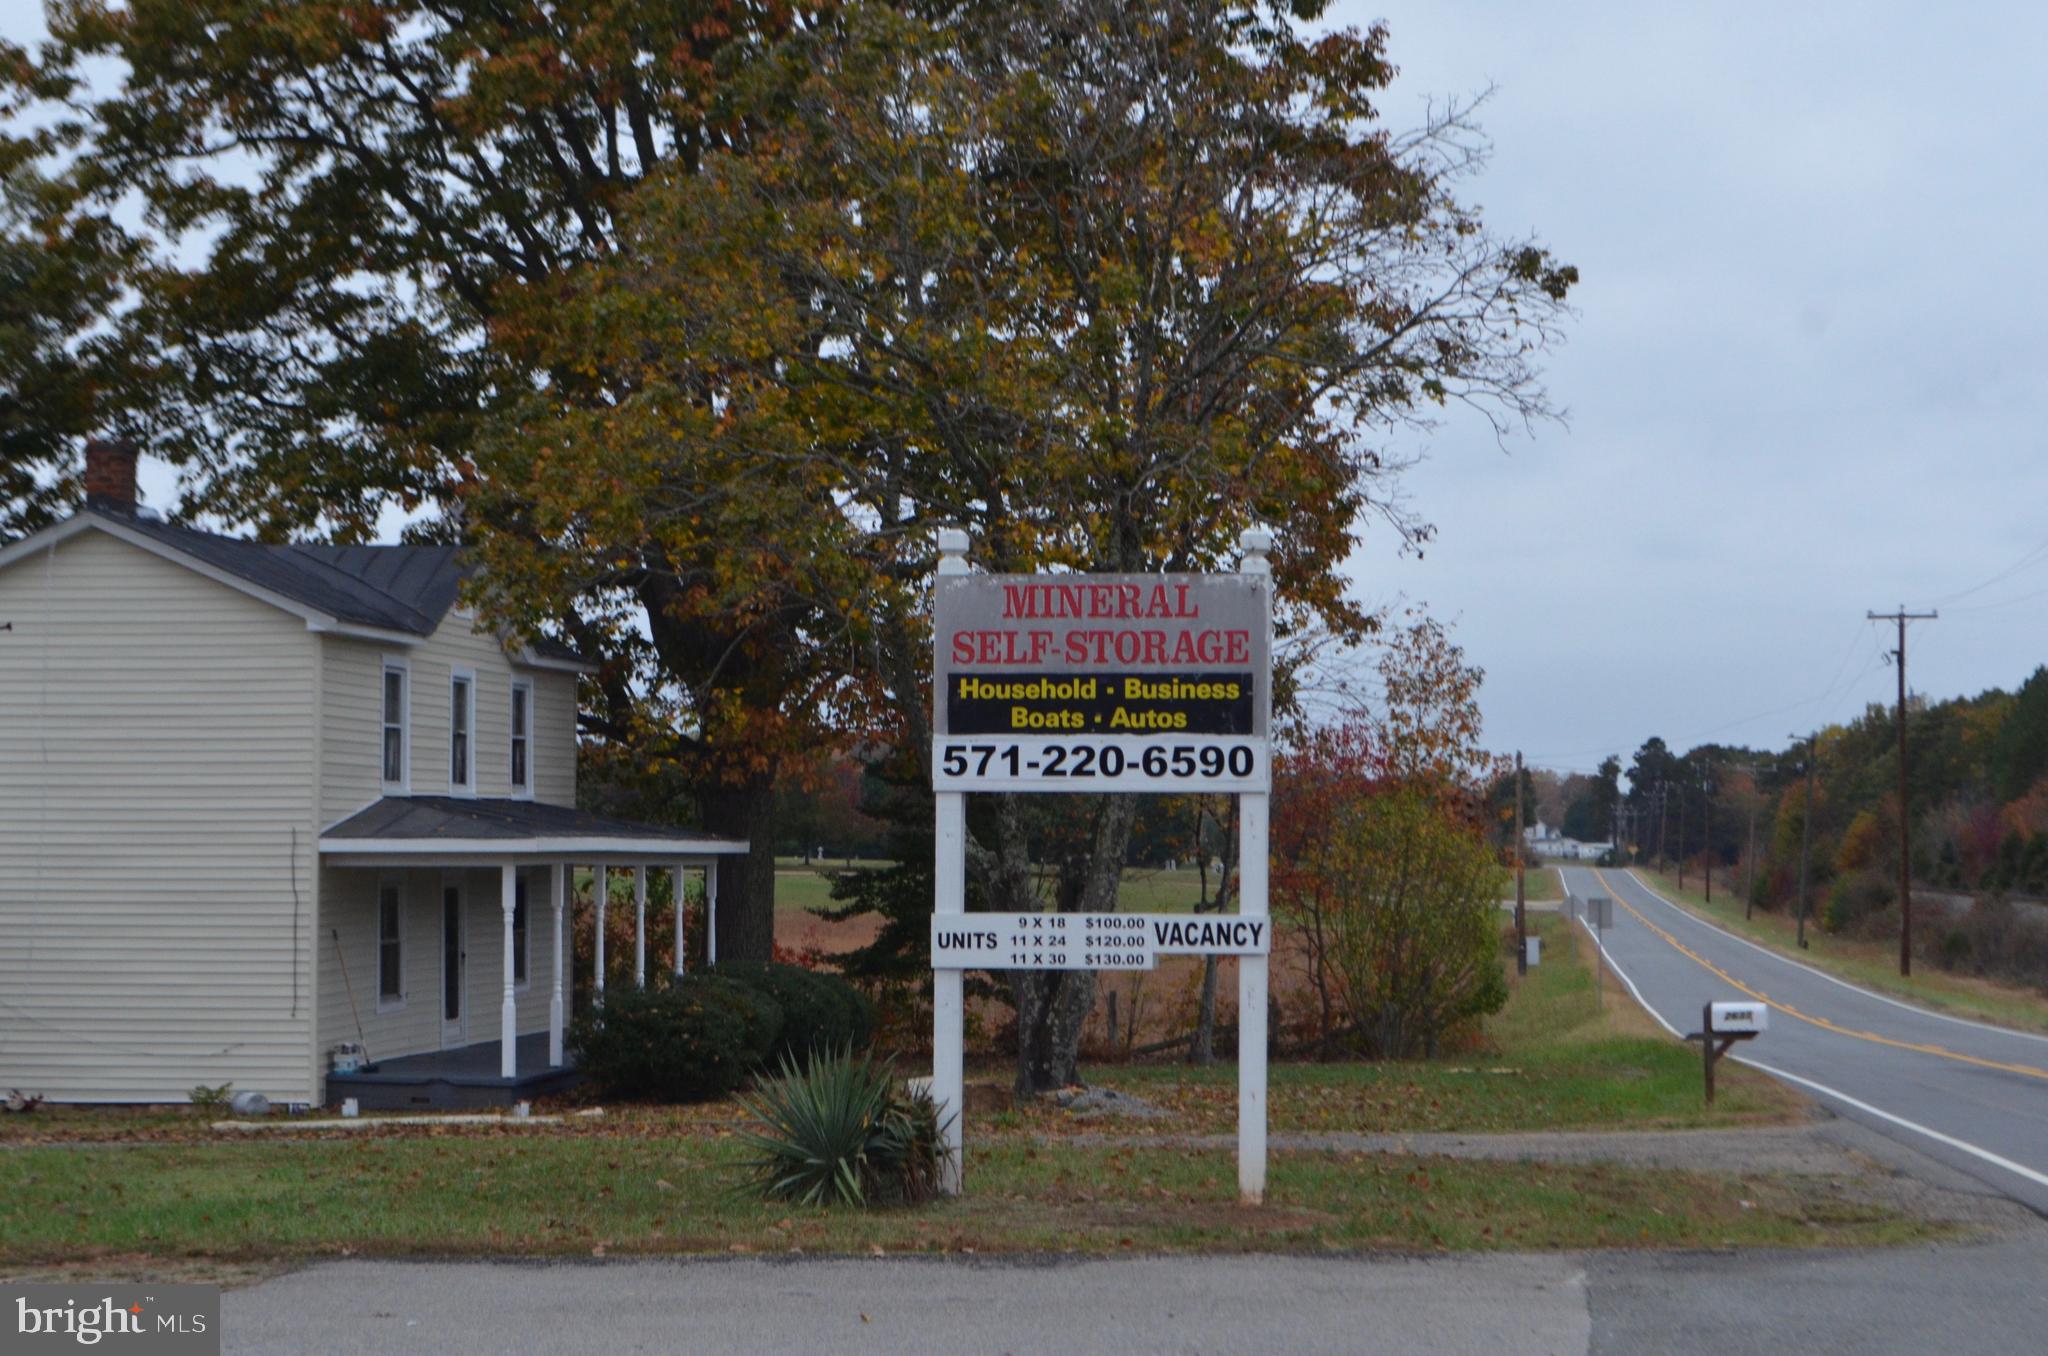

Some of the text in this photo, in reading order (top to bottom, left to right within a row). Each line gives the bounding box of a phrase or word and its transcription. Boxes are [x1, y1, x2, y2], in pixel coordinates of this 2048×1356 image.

[1002, 583, 1199, 619] MINERAL
[952, 630, 1250, 665] SELF-STORAGE
[959, 677, 1240, 700] Household Business
[1011, 706, 1187, 729] Boats Autos
[942, 744, 1254, 778] 571-220-6590
[1018, 917, 1145, 930] 9 X 18 $100.00
[1154, 921, 1264, 947] VACANCY
[937, 932, 998, 950] UNITS
[1010, 935, 1145, 948] 11 X 24 $120.00
[1010, 953, 1145, 966] 11 X 30 $130.00
